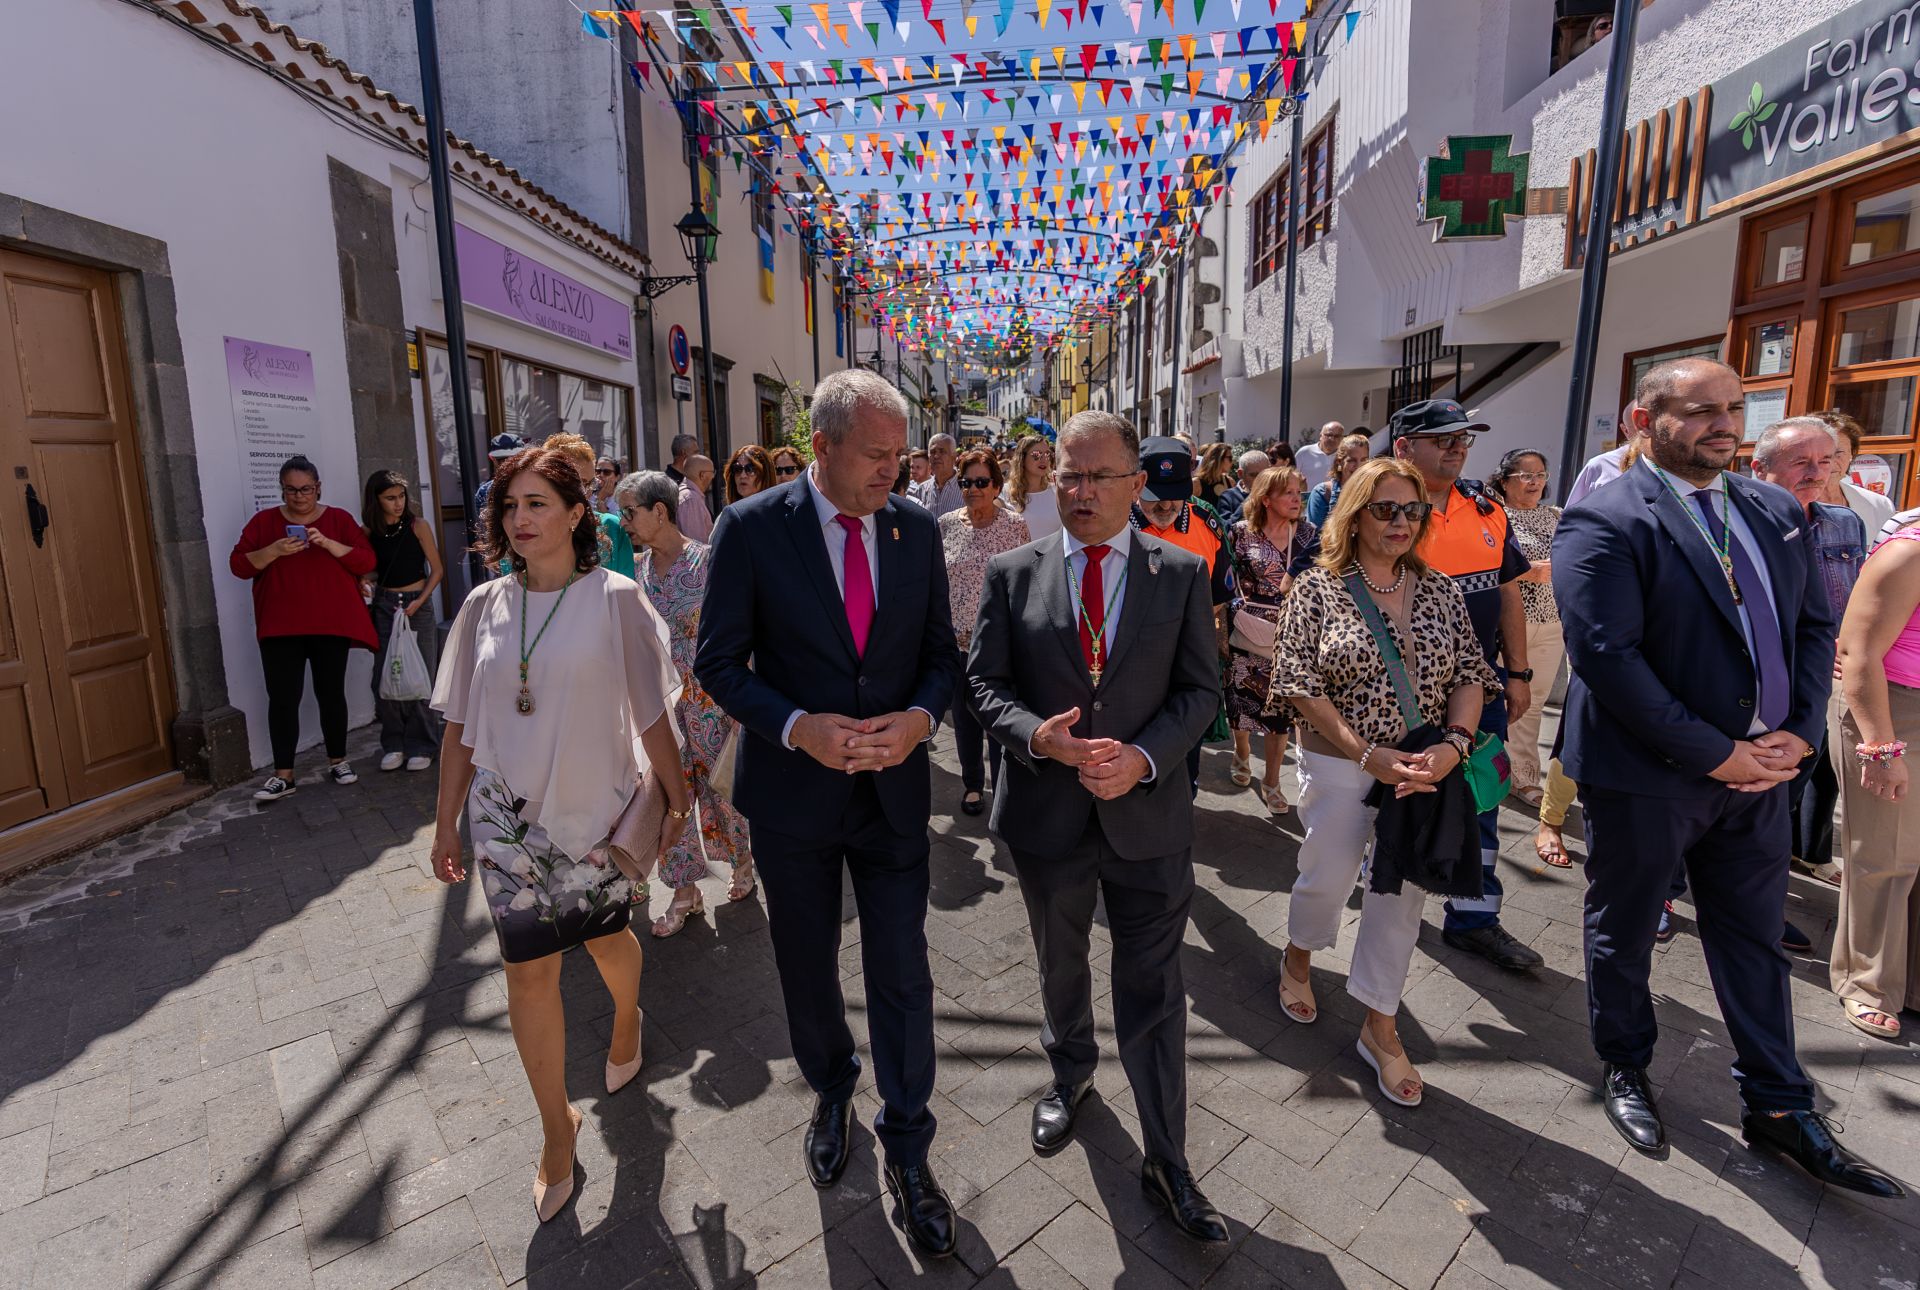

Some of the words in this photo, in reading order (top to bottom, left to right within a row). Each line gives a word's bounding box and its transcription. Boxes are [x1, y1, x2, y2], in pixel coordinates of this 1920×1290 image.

[530, 269, 594, 324] ALENZO
[265, 357, 300, 372] ALENZO
[241, 389, 269, 398] SERVICIOS
